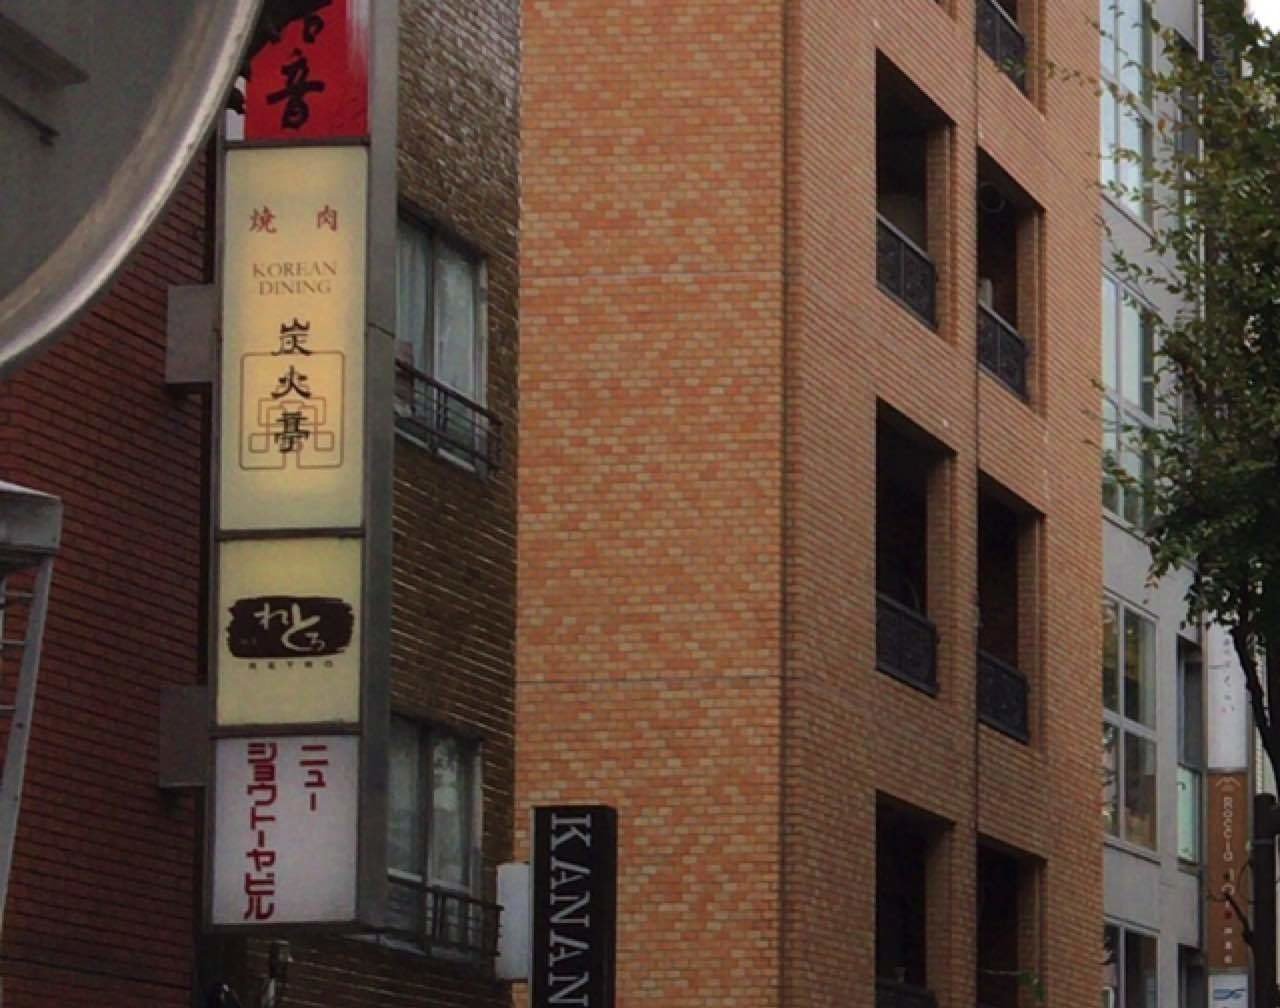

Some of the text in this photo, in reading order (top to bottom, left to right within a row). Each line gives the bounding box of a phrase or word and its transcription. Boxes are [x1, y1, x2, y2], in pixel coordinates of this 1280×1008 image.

[252, 261, 338, 278] KOREAN
[258, 280, 332, 296] DINING
[299, 744, 329, 812] ニュー
[546, 813, 592, 1008] KANAN
